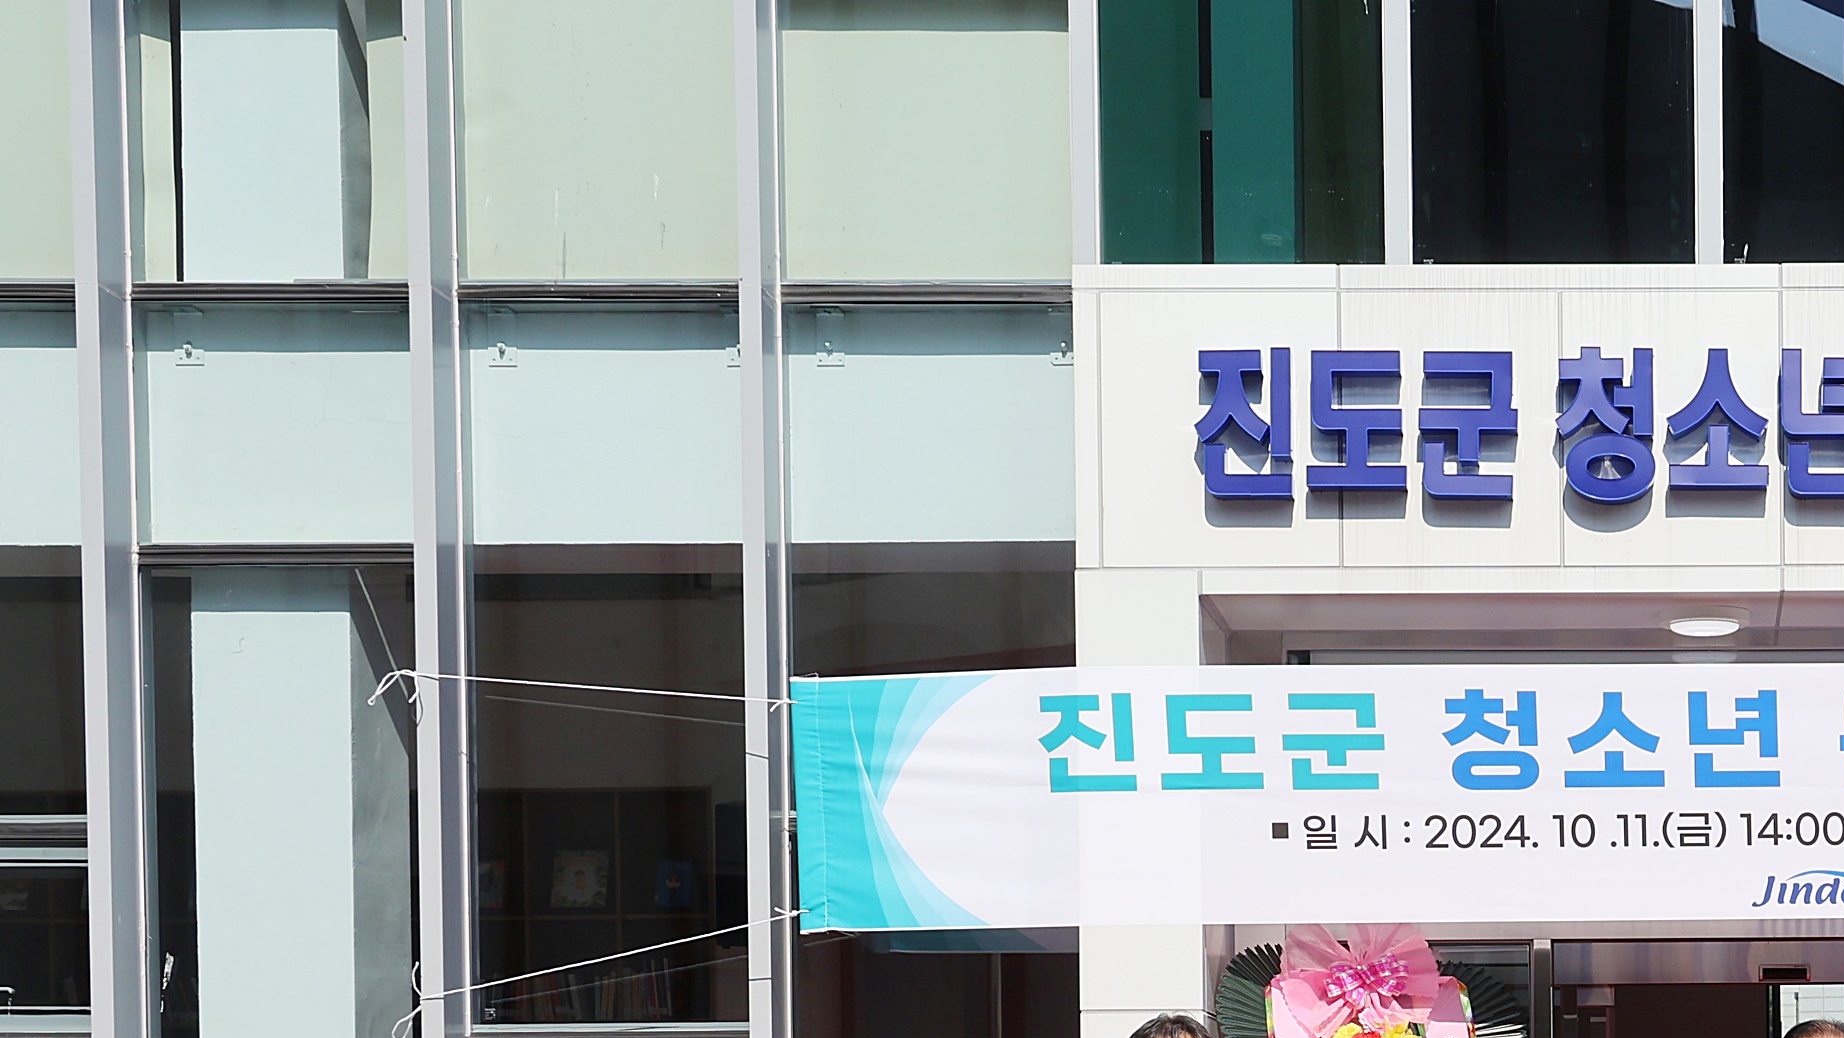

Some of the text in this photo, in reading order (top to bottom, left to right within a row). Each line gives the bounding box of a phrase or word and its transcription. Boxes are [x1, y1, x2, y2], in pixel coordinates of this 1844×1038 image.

[1198, 346, 1518, 501] 진도군
[1038, 692, 1385, 793] 진도군
[1442, 689, 1781, 791] 청소년
[1303, 815, 1338, 849] 일
[1424, 814, 1539, 849] 2024.
[1552, 814, 1596, 848] 10
